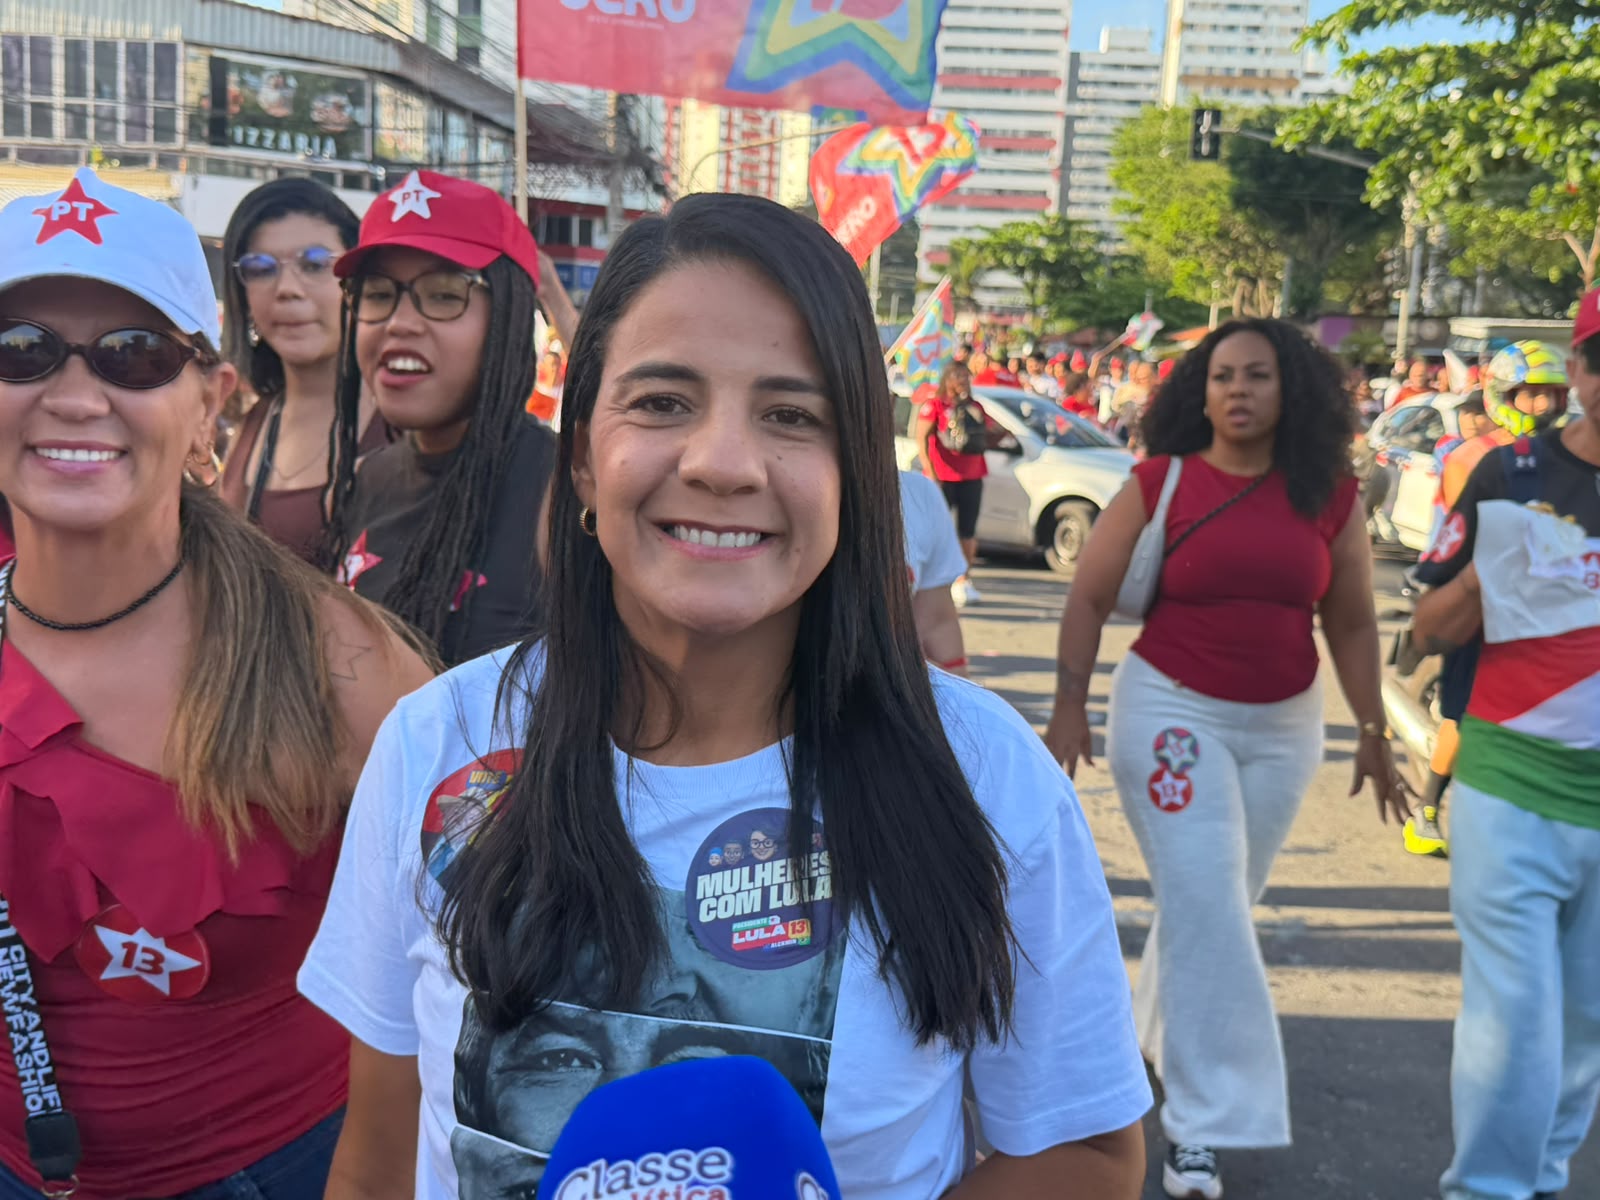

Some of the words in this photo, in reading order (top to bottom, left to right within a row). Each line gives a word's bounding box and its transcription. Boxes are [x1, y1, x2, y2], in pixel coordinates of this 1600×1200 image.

[227, 125, 337, 160] IZZARIA
[51, 201, 95, 222] PT
[402, 190, 424, 205] PT
[699, 888, 762, 923] COM
[732, 924, 787, 944] LULA
[790, 920, 807, 936] 13
[121, 941, 166, 976] 13
[555, 1149, 730, 1200] Classe
